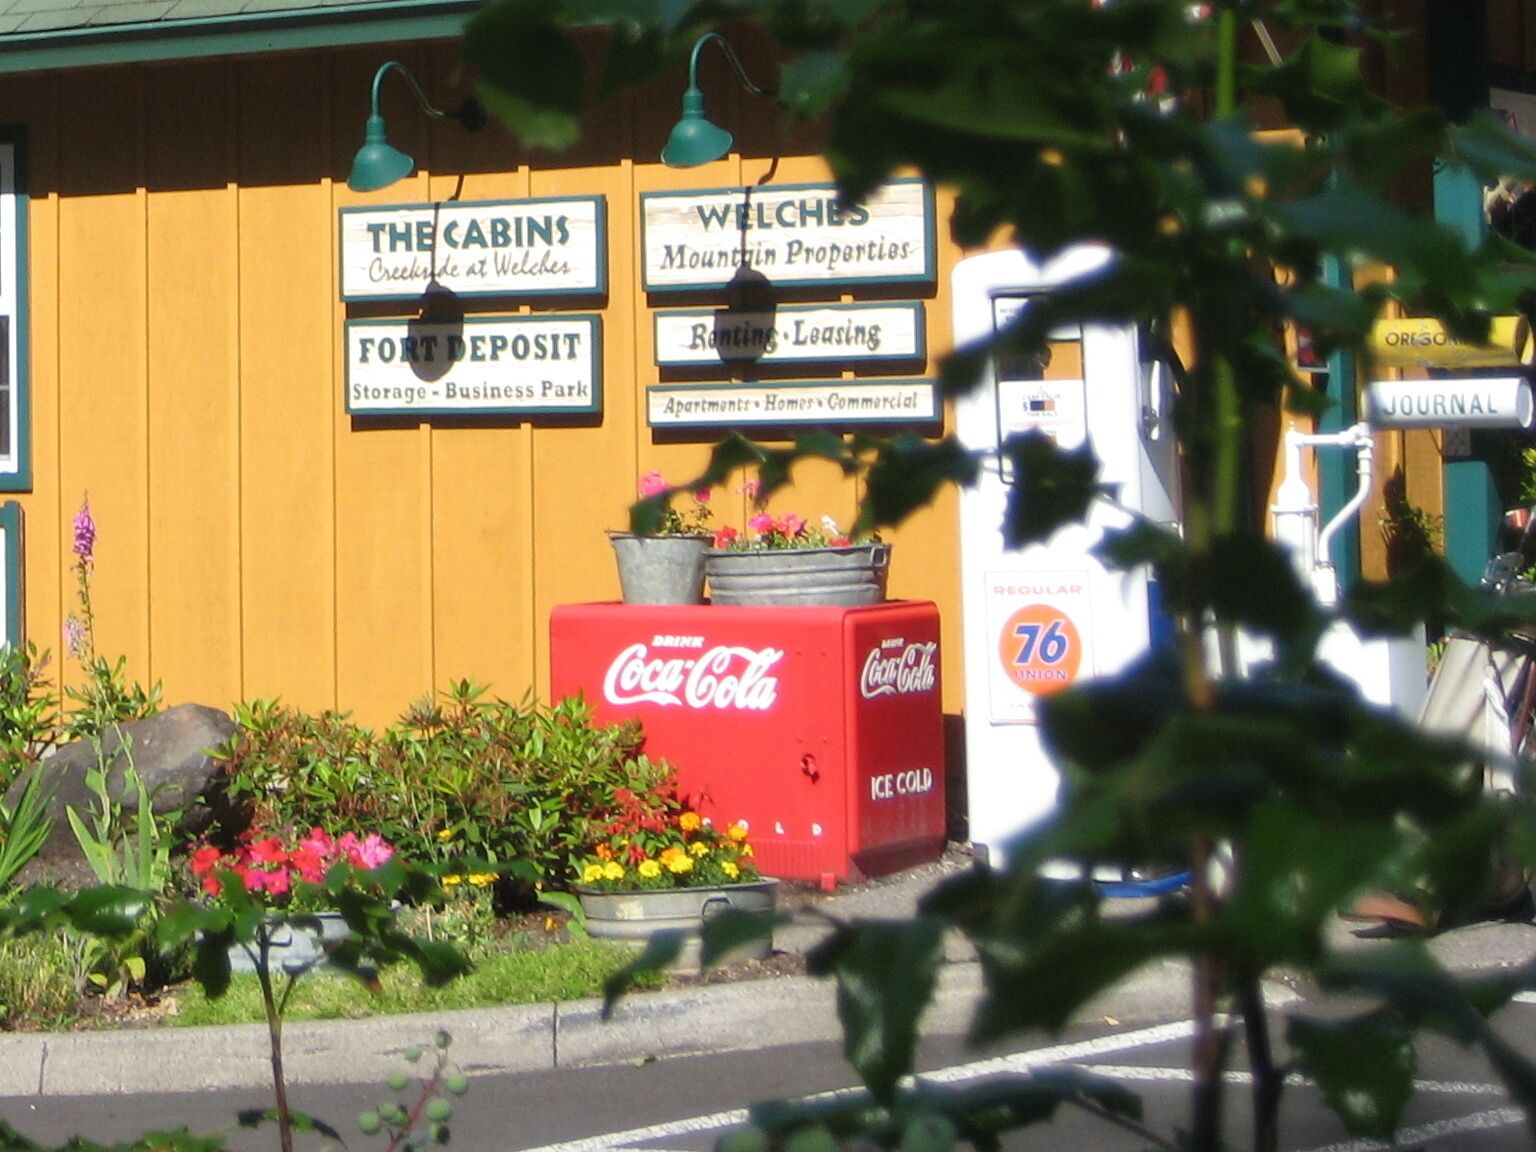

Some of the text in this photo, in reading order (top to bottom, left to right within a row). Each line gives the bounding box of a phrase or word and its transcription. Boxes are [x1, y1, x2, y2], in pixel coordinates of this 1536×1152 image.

[696, 198, 870, 232] WELCHES
[366, 214, 570, 254] THE CABINS
[466, 254, 489, 279] at
[494, 249, 571, 278] Welches
[660, 235, 911, 270] Mountain Properties
[359, 332, 581, 364] FORT DEPOSIT
[690, 318, 881, 354] Renting Leasing
[1385, 332, 1461, 347] OREGO
[353, 383, 427, 404] Storage
[445, 381, 535, 399] Business
[541, 379, 588, 398] Park
[663, 391, 918, 418] Apartments Homes Commercial
[1383, 393, 1498, 417] JOURNAL
[993, 584, 1083, 596] REGULAR
[652, 635, 705, 648] DRINK
[1014, 620, 1068, 665] 76
[603, 644, 784, 710] Coca-Cola
[860, 642, 937, 699] Coca-Cola
[1015, 669, 1067, 680] UNION
[871, 768, 932, 800] ICE COLD
